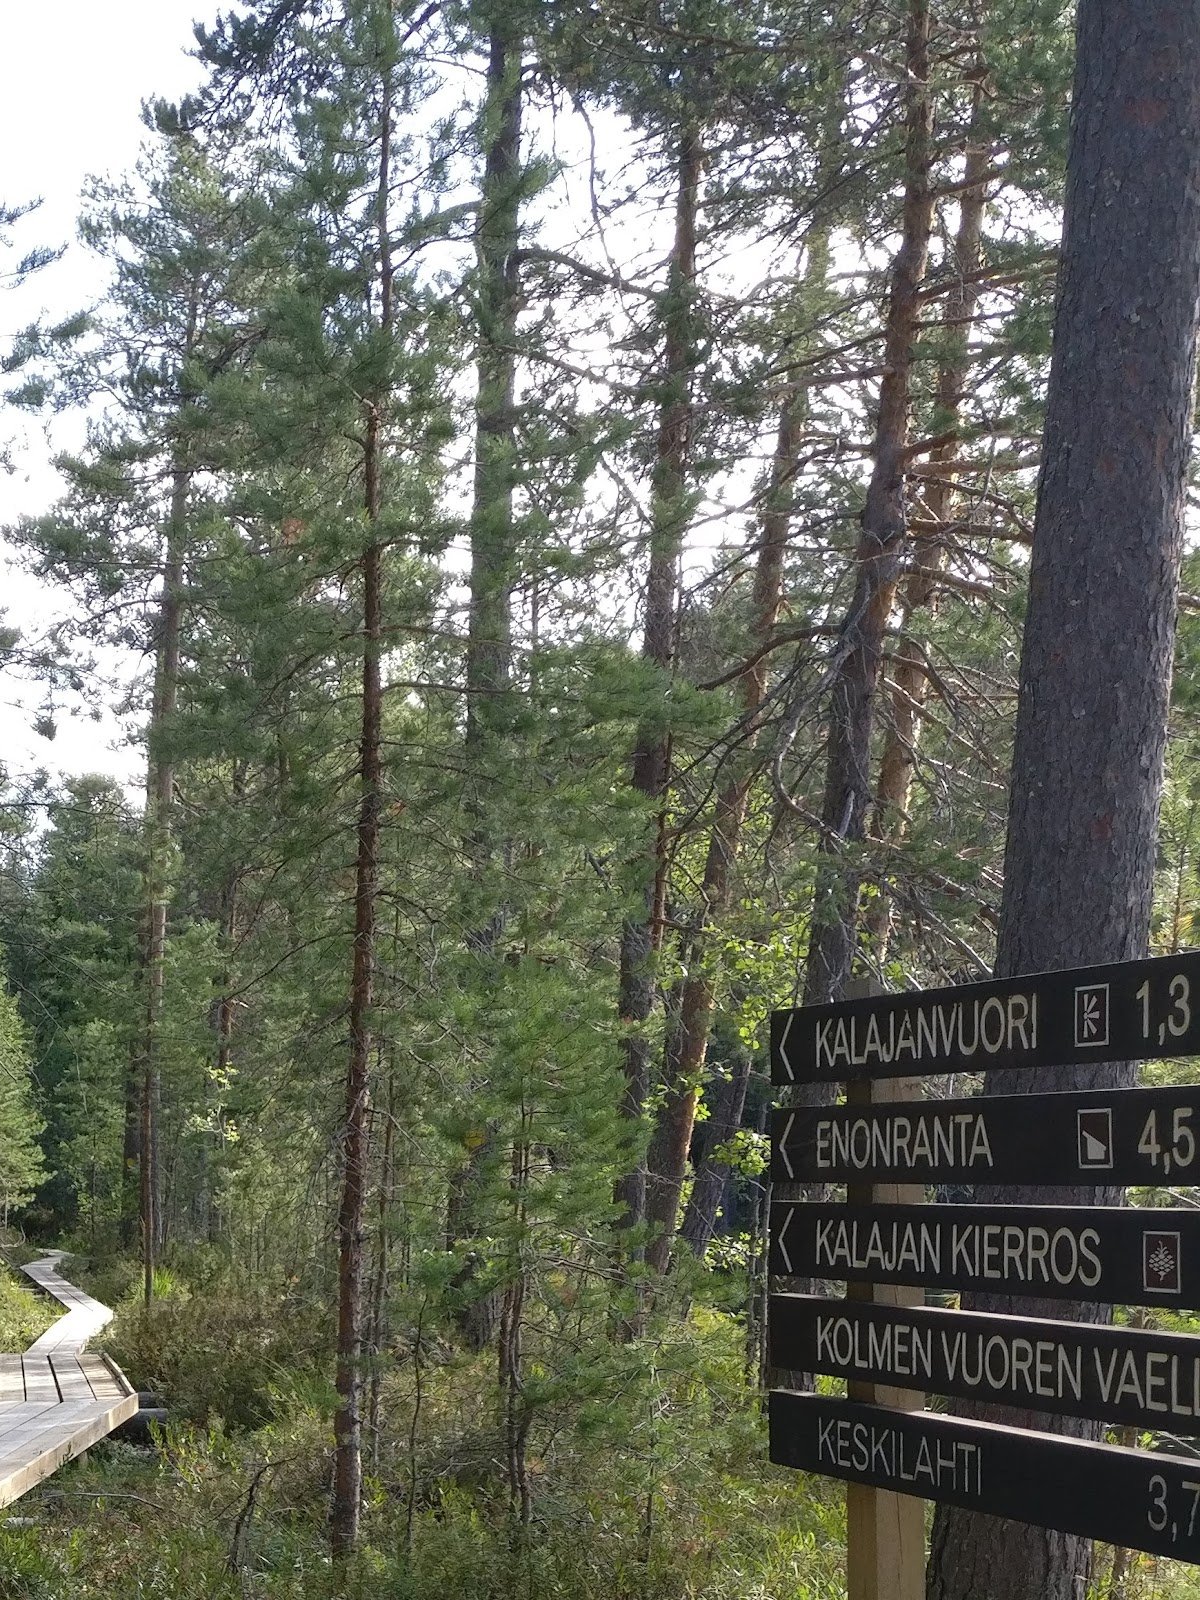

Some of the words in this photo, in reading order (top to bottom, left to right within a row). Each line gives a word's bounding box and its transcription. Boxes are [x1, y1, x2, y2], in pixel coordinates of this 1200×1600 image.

[815, 992, 1037, 1068] KALAJANVUORI
[1136, 974, 1191, 1046] 1,3
[816, 1114, 993, 1169] ENONRANTA
[1137, 1107, 1196, 1175] 4,5
[815, 1219, 941, 1275] KALAJAN
[951, 1224, 1102, 1287] KIERROS
[817, 1315, 932, 1379] KOLMEN
[941, 1330, 1082, 1402] VUOREN
[818, 1416, 982, 1496] KESKILAHTI
[1147, 1474, 1200, 1542] 3,7
